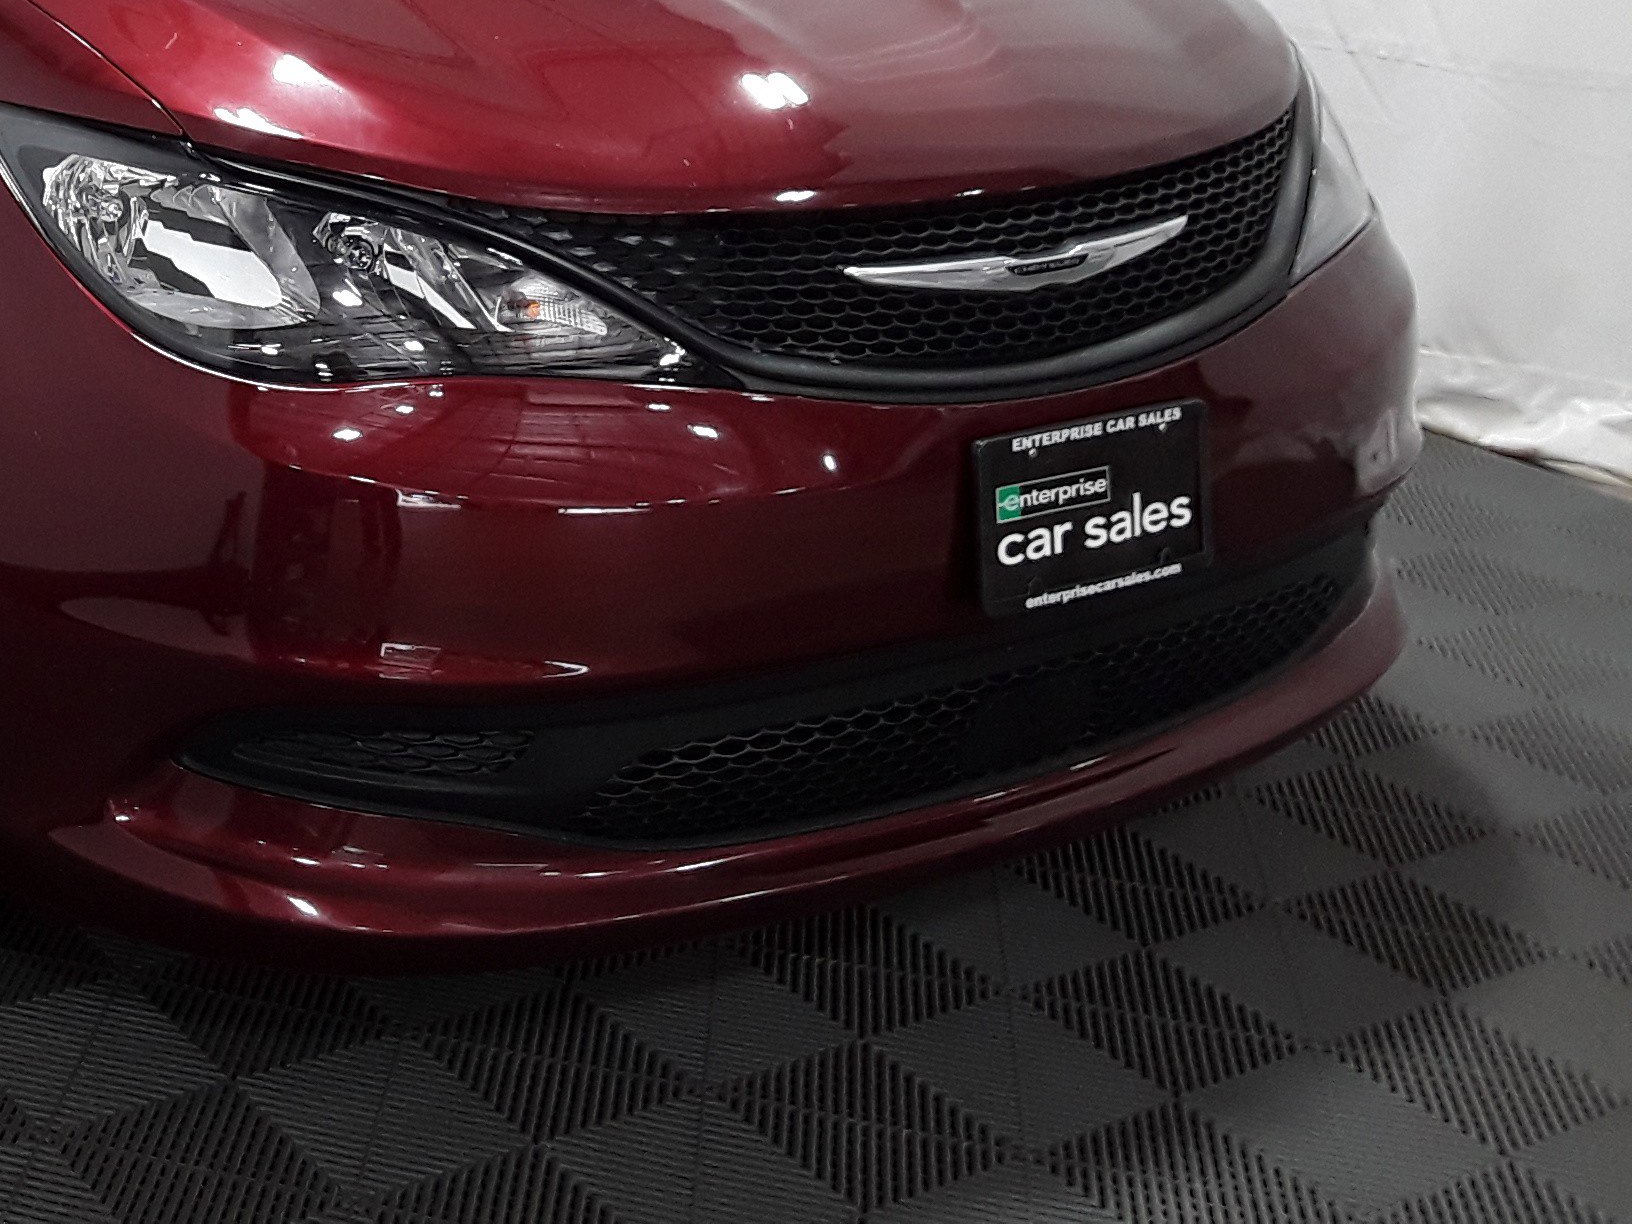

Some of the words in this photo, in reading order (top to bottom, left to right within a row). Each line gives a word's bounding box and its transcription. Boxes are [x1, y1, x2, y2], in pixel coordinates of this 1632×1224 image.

[1012, 422, 1103, 452] ENTERPRISE
[1106, 416, 1135, 434] CAR
[1138, 407, 1182, 427] SALES
[1003, 478, 1108, 511] enterprise
[996, 520, 1074, 566] car
[1083, 491, 1193, 549] sales
[1025, 563, 1182, 609] enterprisecarsales.com
